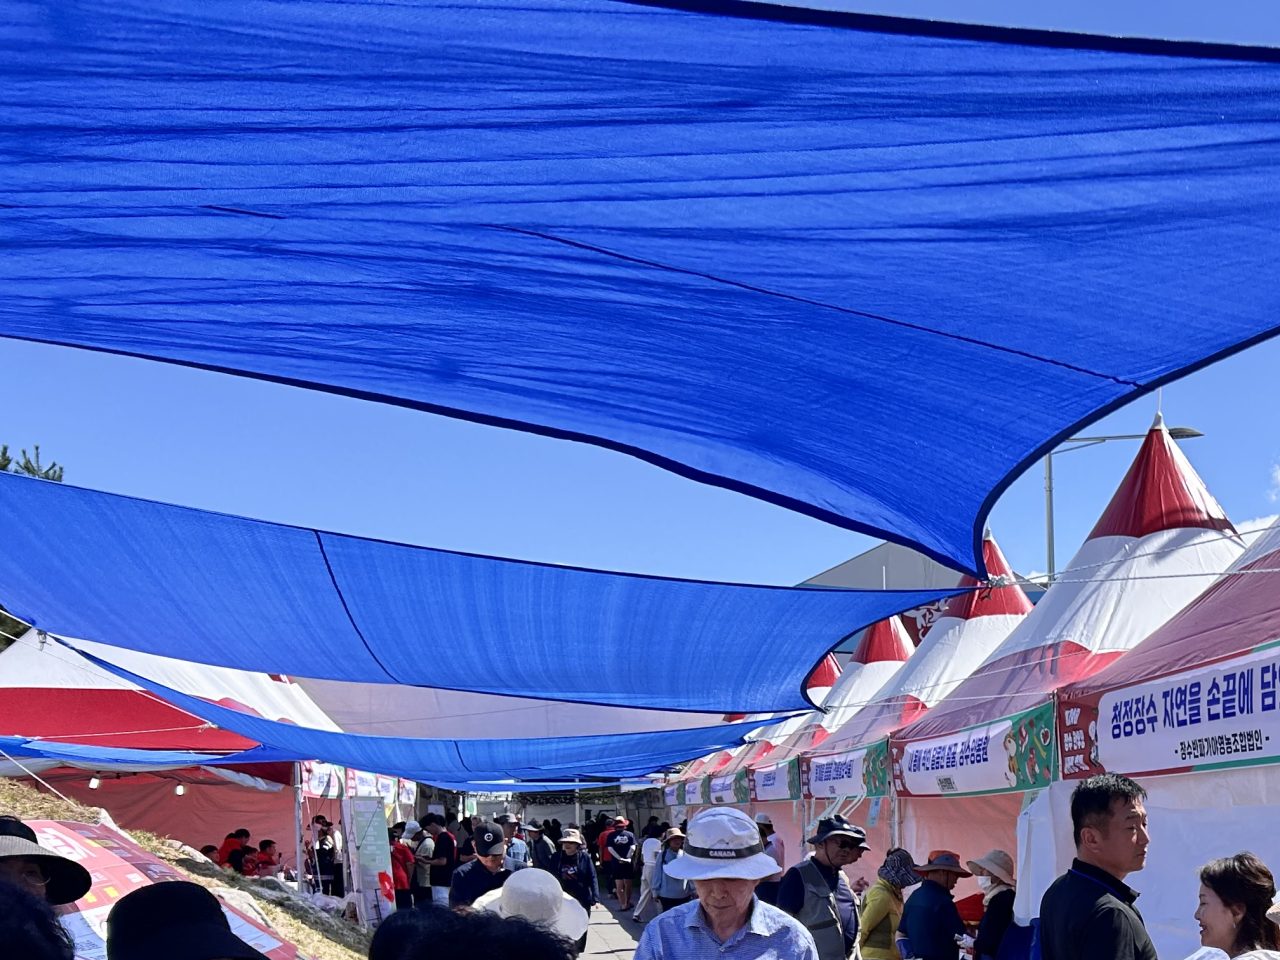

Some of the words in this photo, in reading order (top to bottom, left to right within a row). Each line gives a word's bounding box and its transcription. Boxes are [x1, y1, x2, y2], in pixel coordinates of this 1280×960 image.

[1111, 693, 1158, 739] 청정장수
[1162, 681, 1202, 729] 자연을
[1206, 667, 1254, 722] 손끝에
